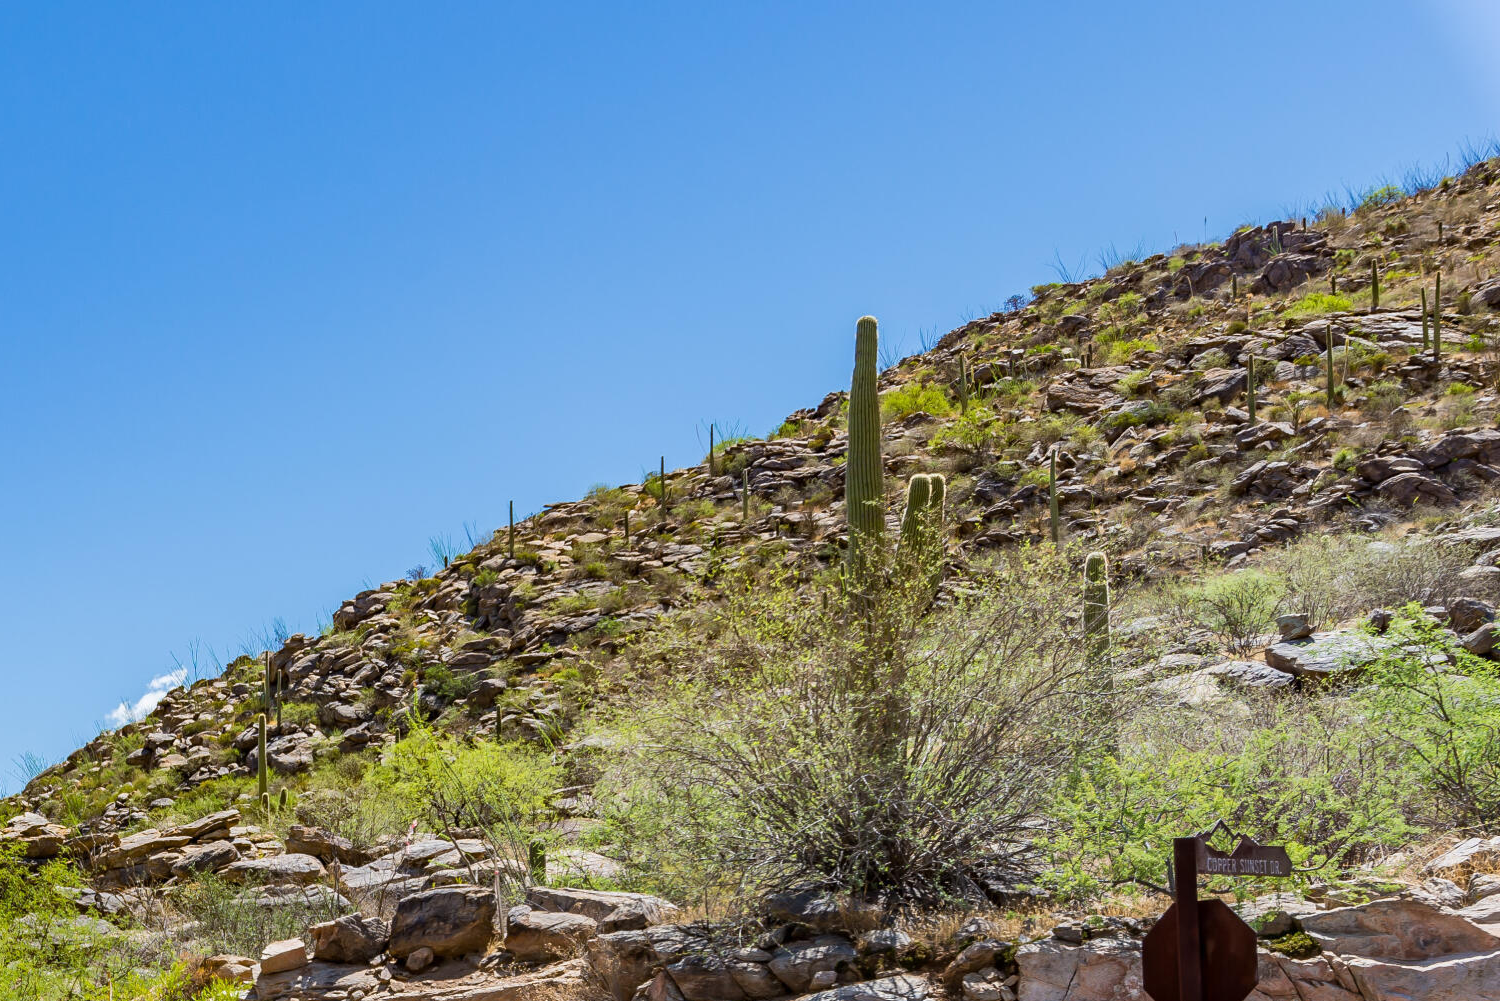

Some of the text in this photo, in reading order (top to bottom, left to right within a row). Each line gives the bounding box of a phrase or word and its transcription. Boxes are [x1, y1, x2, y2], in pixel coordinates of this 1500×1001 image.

[1207, 857, 1282, 875] COPPER SUNSET DR.
